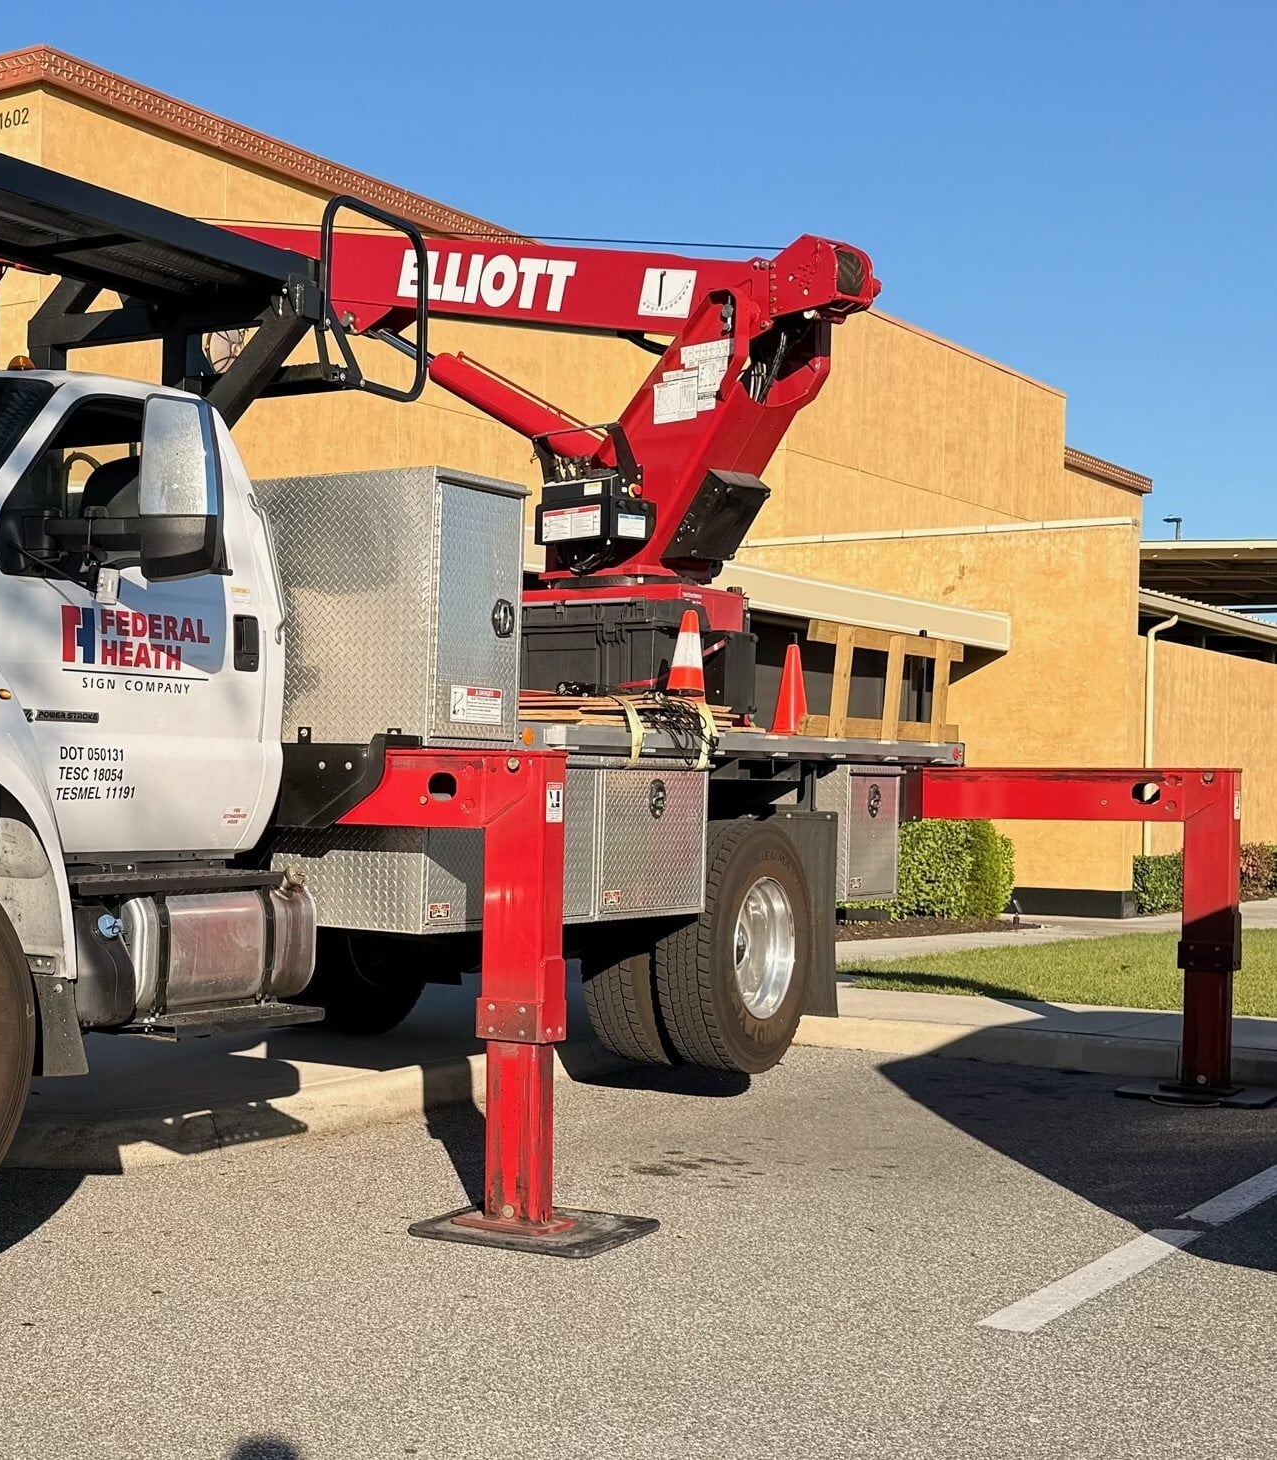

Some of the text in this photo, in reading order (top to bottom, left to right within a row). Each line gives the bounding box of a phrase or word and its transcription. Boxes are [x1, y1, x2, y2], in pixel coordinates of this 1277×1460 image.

[397, 248, 577, 312] ELLIOTT
[100, 608, 210, 644] FEDERAL
[101, 639, 181, 671] HEATH
[82, 677, 191, 695] SIGN COMPANY
[38, 711, 99, 720] POWER STROKE
[59, 745, 124, 762] DOT 050131
[58, 766, 124, 782] TESC 18054
[55, 785, 136, 801] TESMEL 11191
